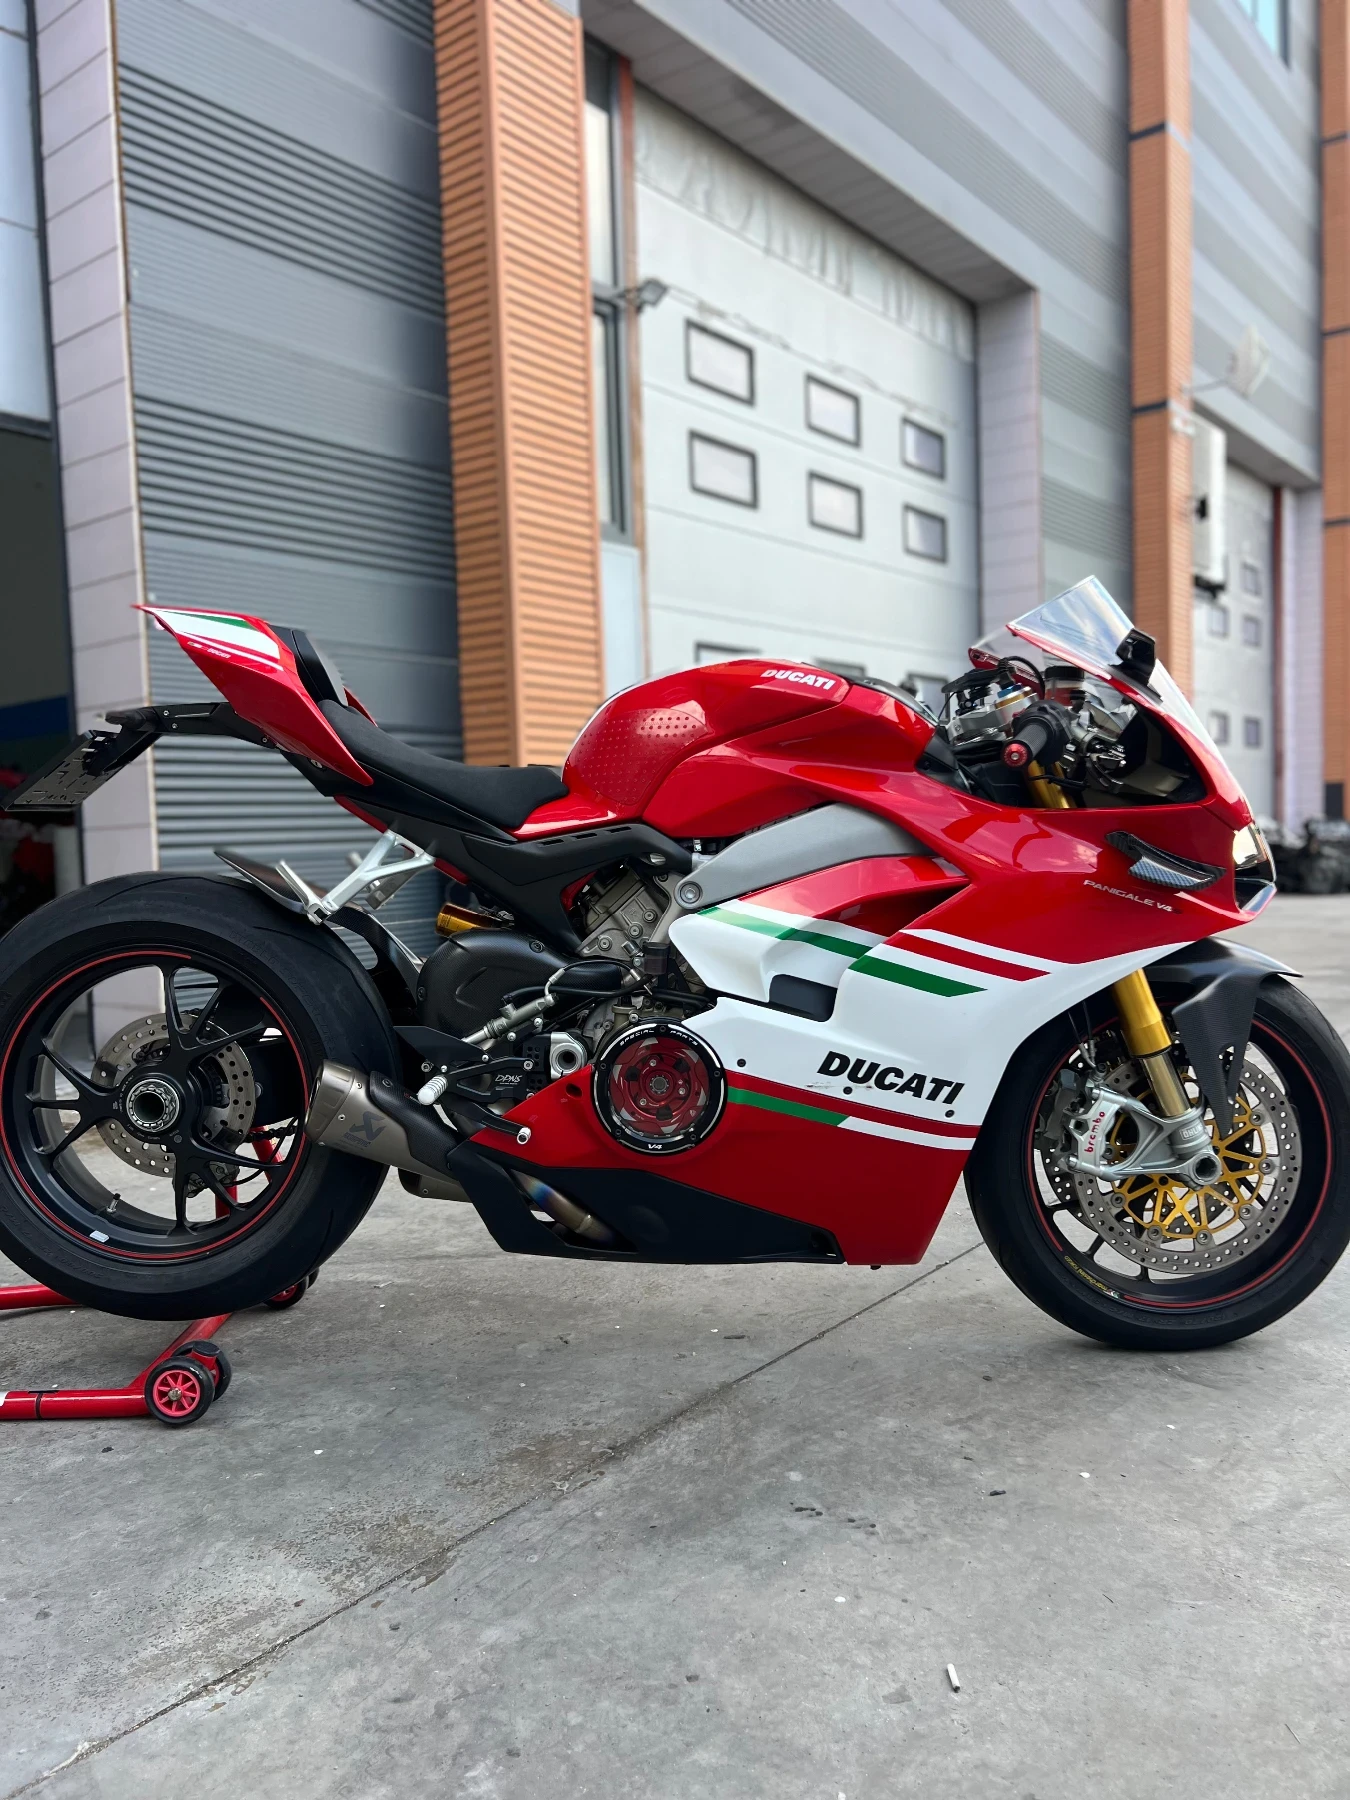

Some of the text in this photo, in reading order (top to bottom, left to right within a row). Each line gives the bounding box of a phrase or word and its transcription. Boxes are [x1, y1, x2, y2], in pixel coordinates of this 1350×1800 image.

[760, 669, 836, 690] DUCATI
[1083, 879, 1173, 912] PANIGALE V4
[619, 1028, 699, 1047] SPECIAL PARTS
[816, 1050, 966, 1105] DUCATI
[1083, 1111, 1106, 1153] brembo
